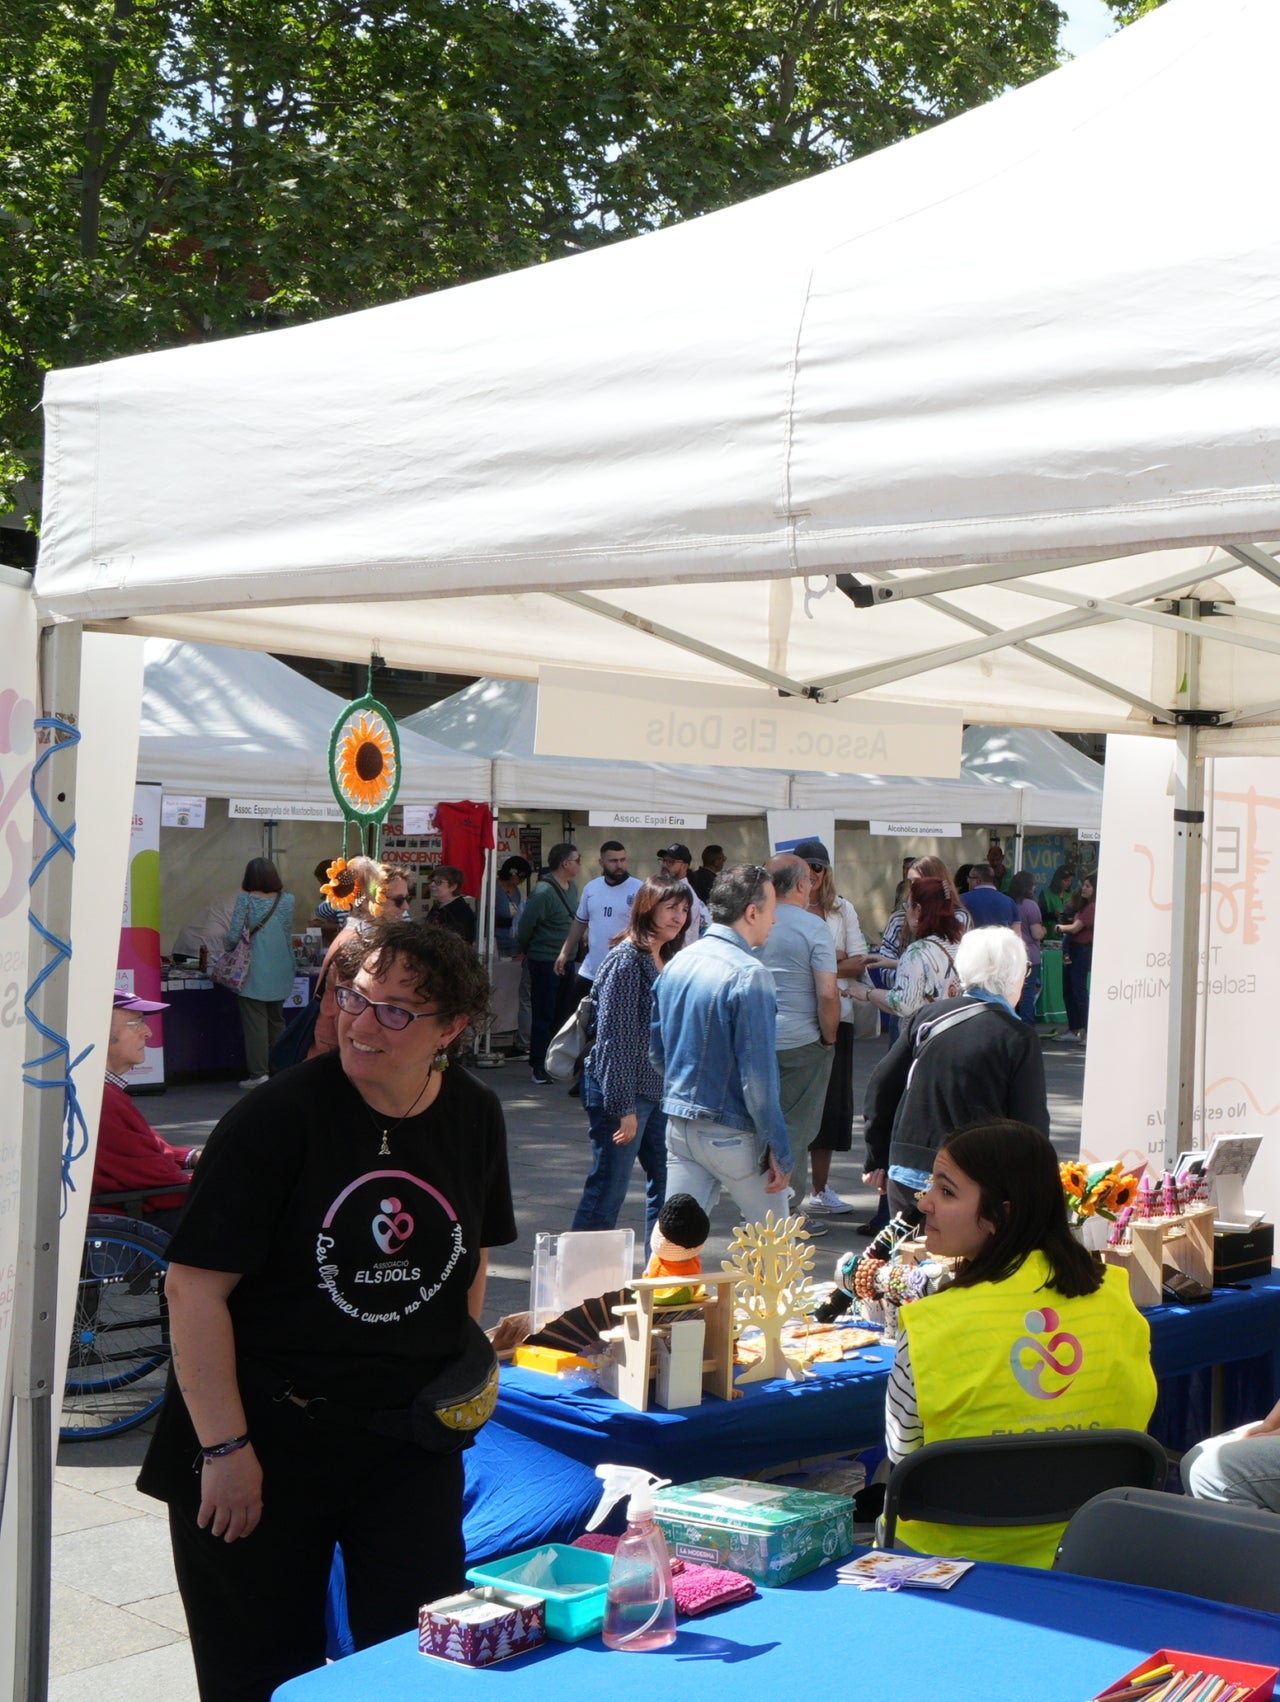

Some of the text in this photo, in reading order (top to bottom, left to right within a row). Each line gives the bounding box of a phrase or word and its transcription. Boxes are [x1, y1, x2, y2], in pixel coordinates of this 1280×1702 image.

[614, 813, 685, 826] Assoc. Espai Eira
[603, 906, 613, 917] 10
[315, 1232, 335, 1264] Les
[404, 1300, 422, 1315] no
[419, 1282, 442, 1302] les
[440, 1222, 467, 1282] amaguis
[354, 1267, 421, 1284] ELS DOLS
